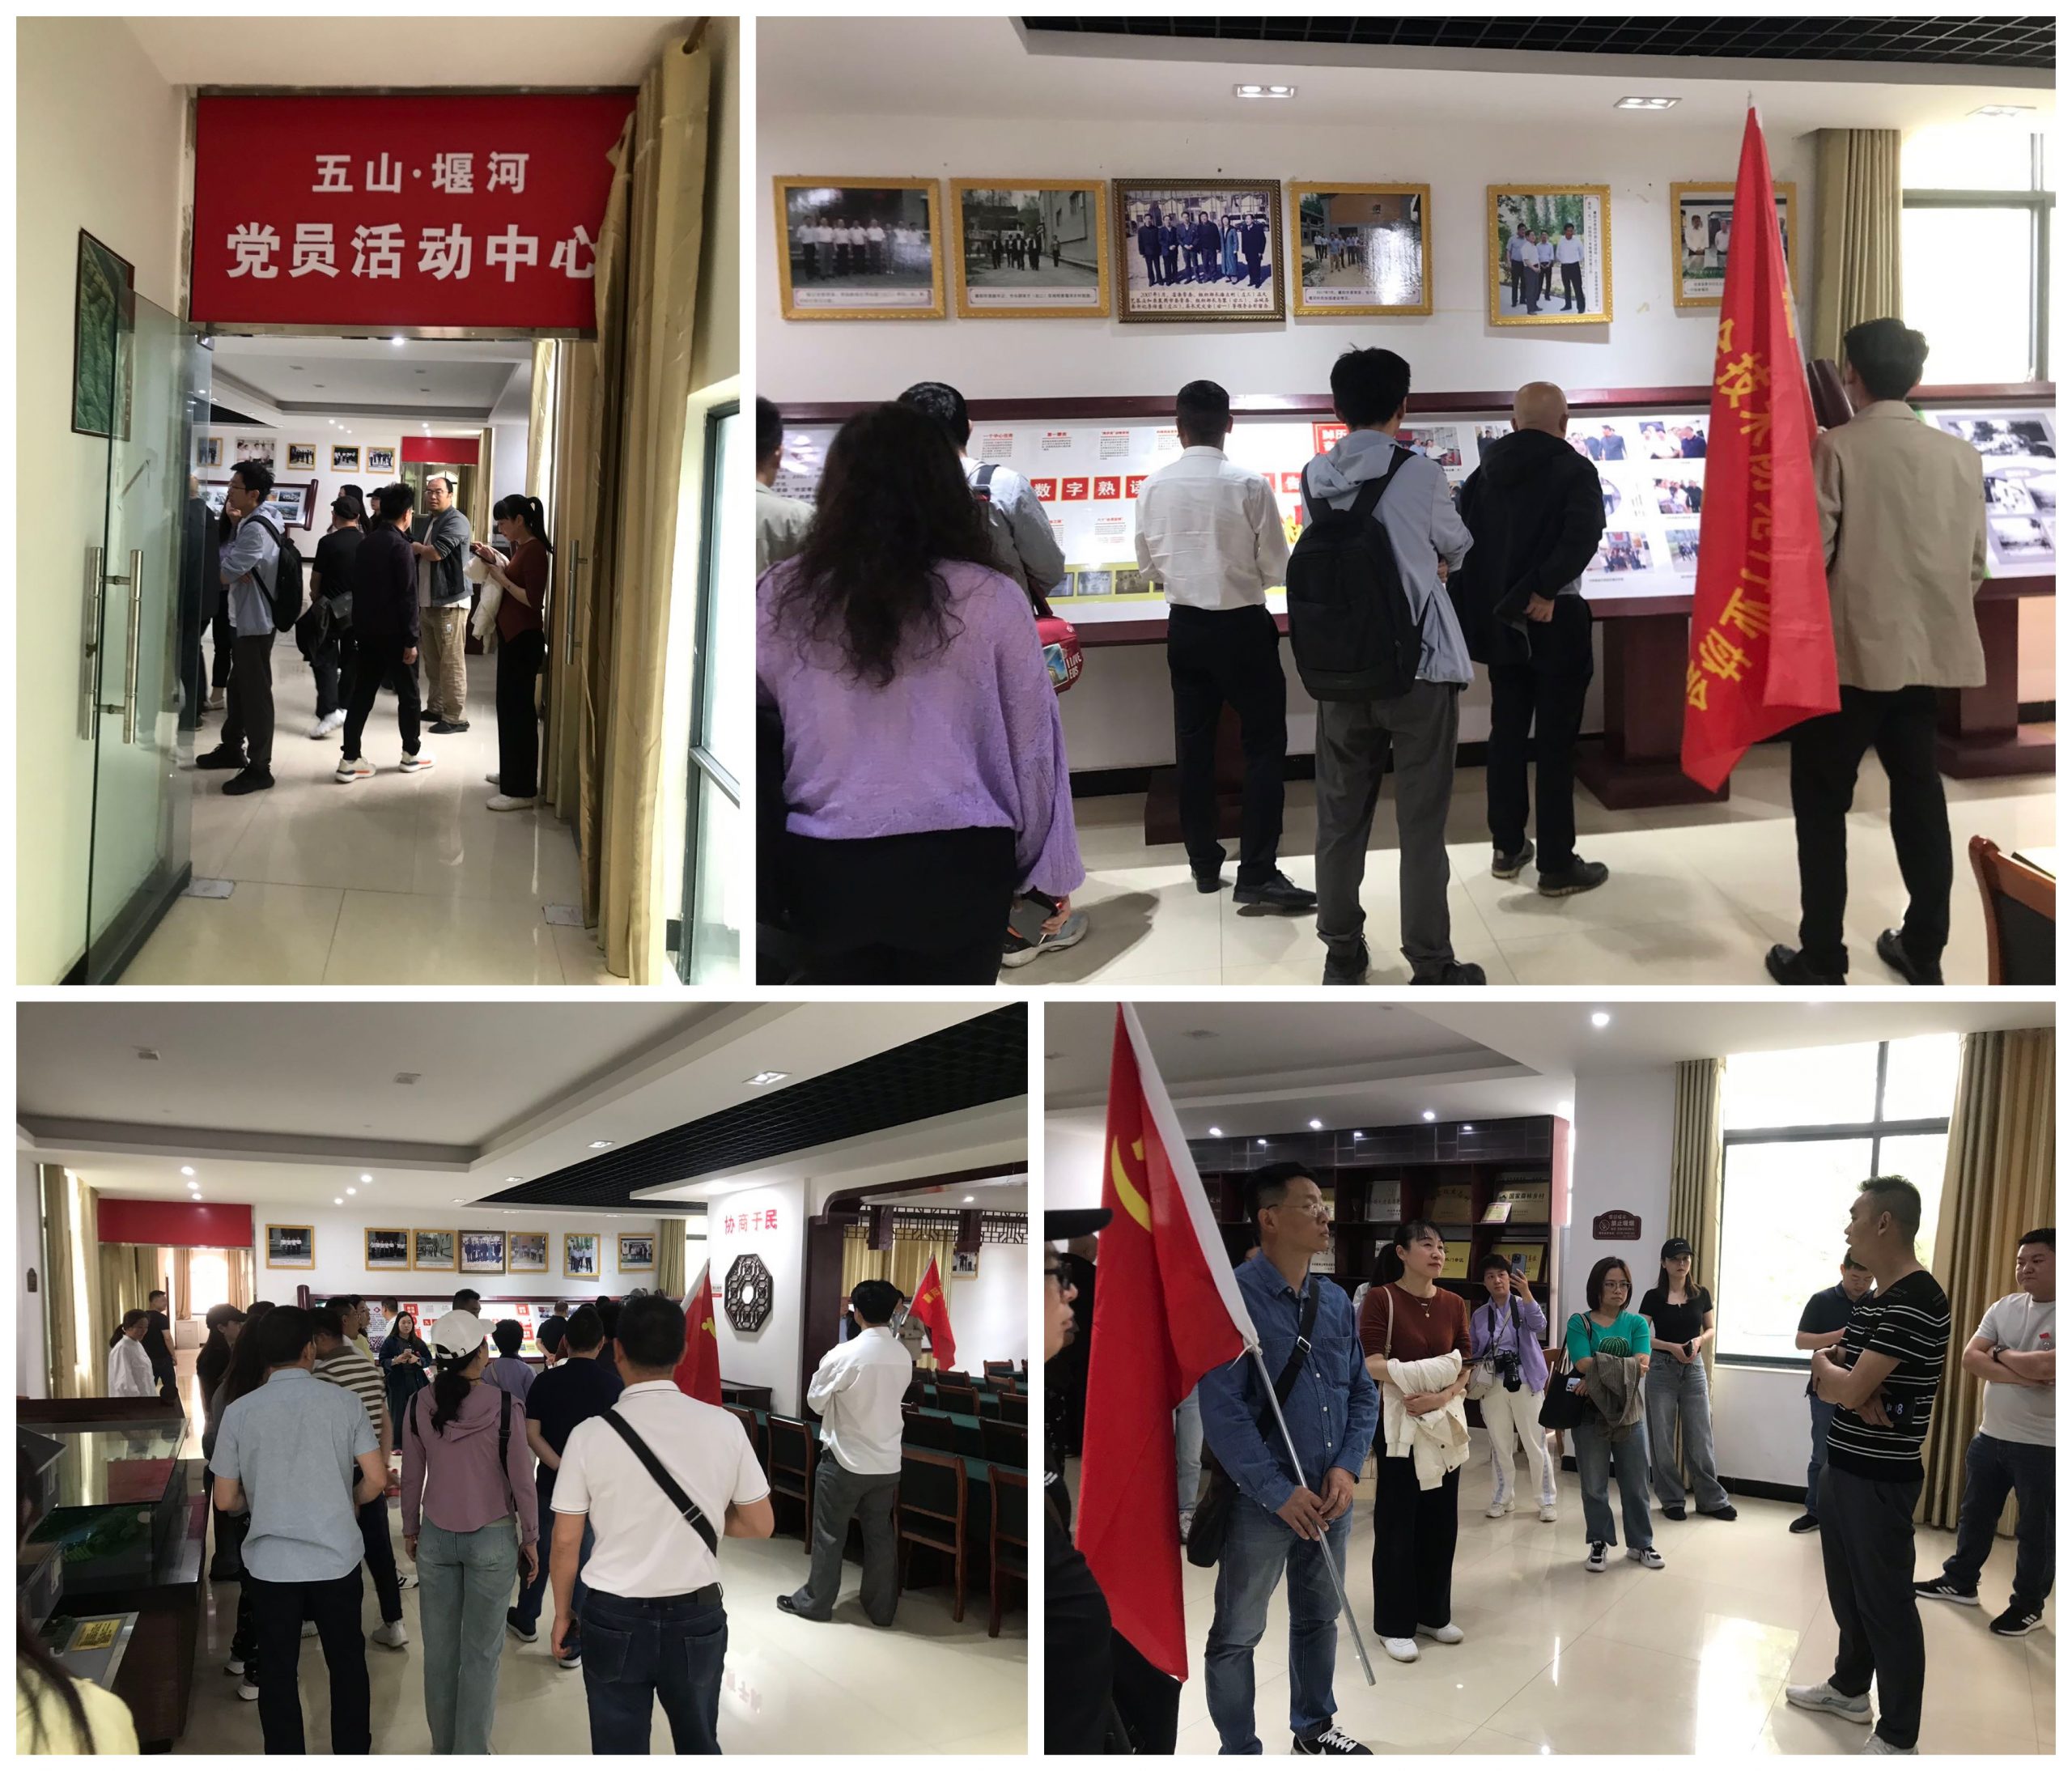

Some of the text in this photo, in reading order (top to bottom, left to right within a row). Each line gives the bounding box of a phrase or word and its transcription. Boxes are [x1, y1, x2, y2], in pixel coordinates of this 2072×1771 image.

[312, 151, 530, 196] 五山·堰河
[225, 222, 596, 283] 党员活动中心
[724, 1209, 778, 1236] 协商于民
